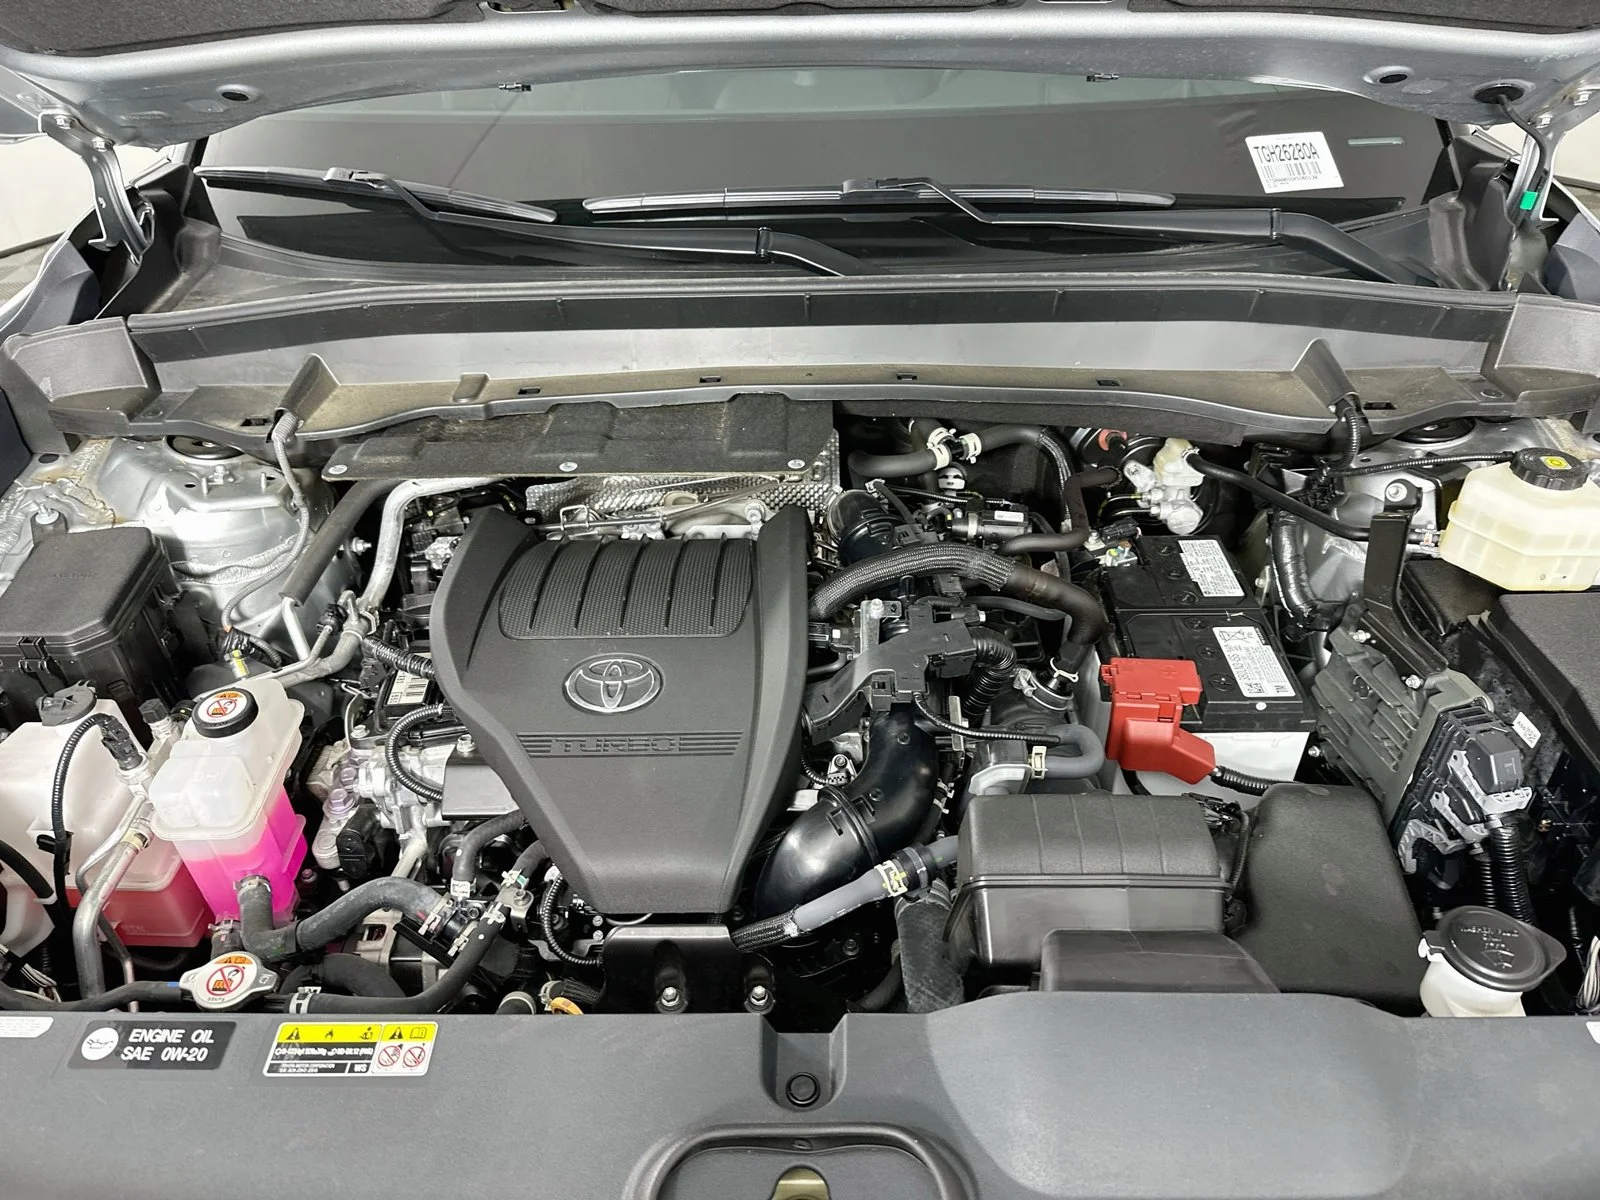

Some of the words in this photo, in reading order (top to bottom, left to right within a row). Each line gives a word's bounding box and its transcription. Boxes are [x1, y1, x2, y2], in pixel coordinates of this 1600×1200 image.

[1253, 142, 1320, 163] TGH26280A
[553, 737, 678, 753] TURBO
[128, 1028, 185, 1043] ENGINE
[190, 1029, 215, 1044] OIL
[120, 1046, 154, 1061] SAE
[160, 1047, 209, 1062] 0W-20
